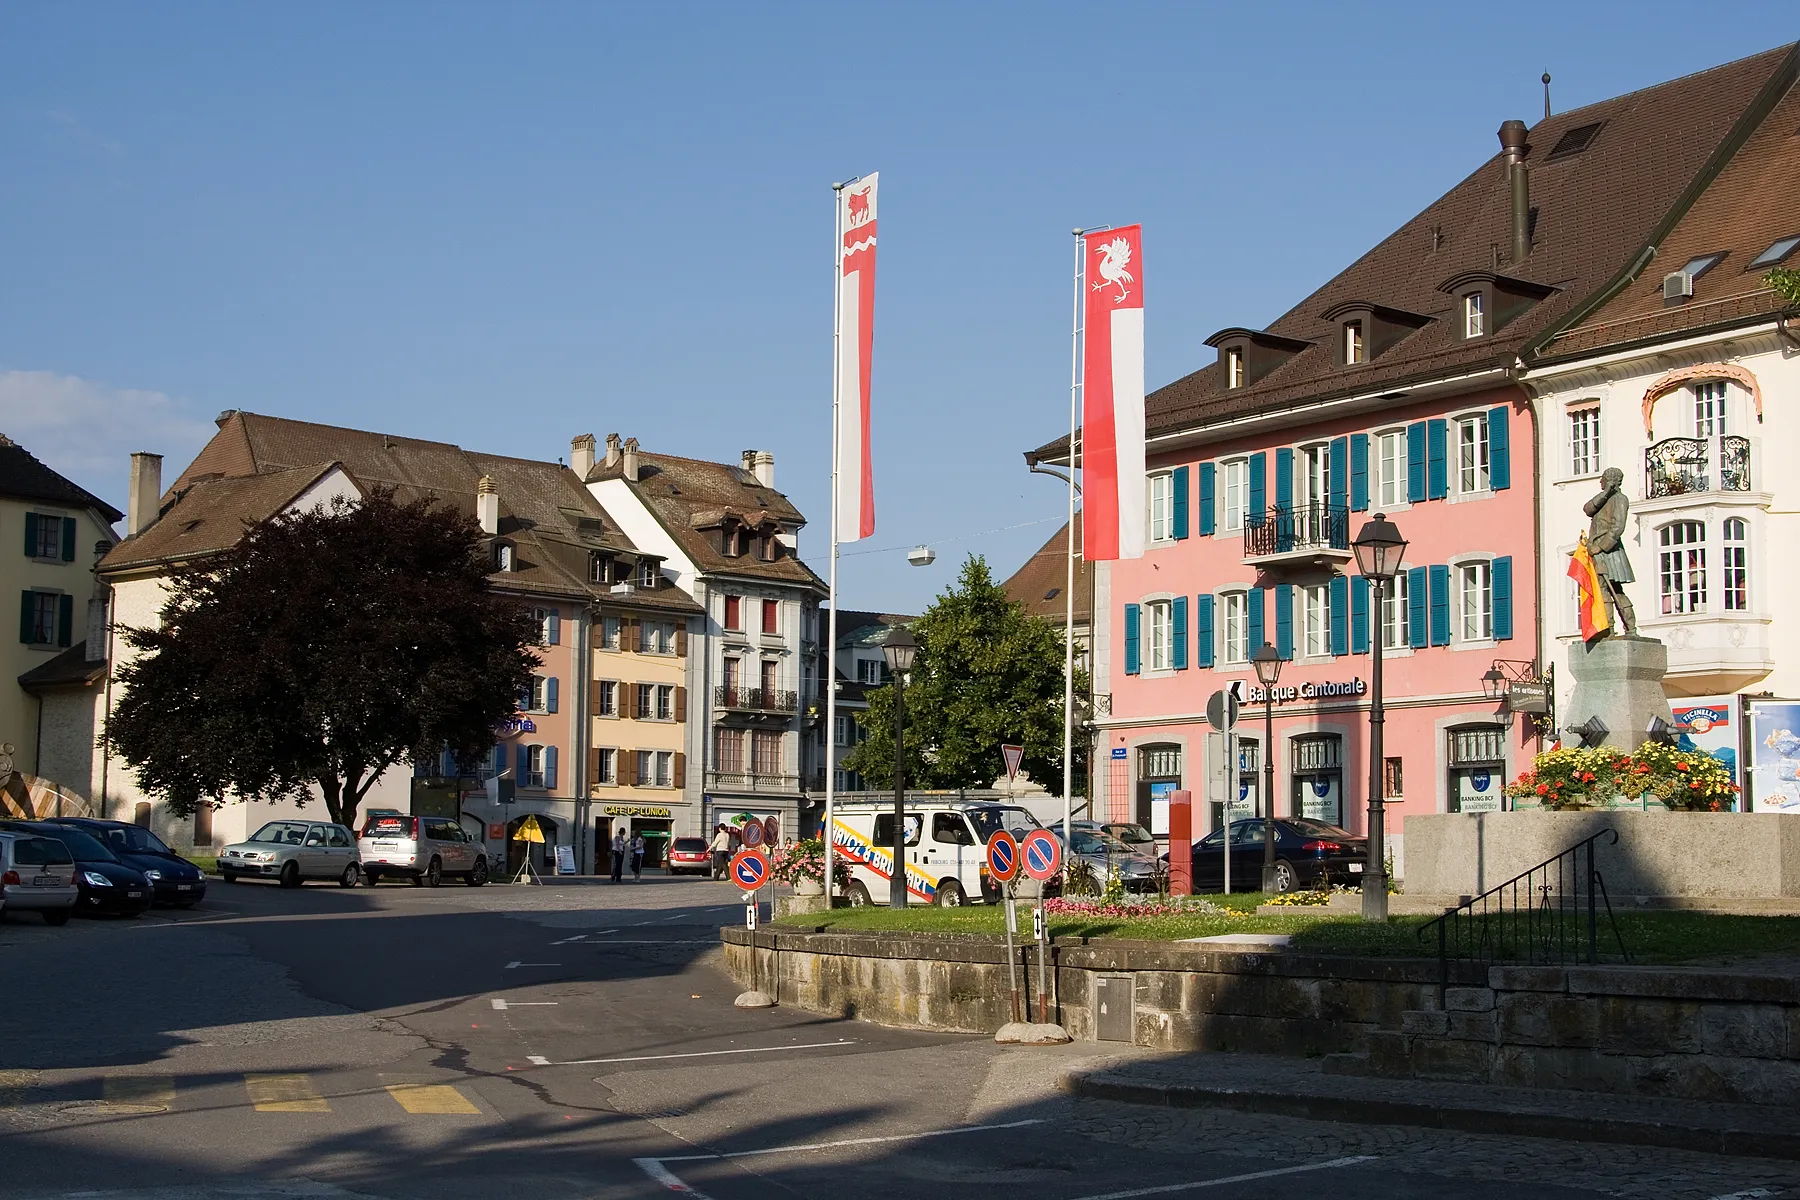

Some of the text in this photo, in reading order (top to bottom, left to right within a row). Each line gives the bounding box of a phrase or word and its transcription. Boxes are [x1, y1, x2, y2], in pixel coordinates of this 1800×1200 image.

[1299, 676, 1364, 698] Cantonale
[1682, 708, 1719, 722] TICINELLA
[604, 805, 626, 816] CAFE
[863, 844, 872, 863] &
[872, 850, 931, 895] BRUART
